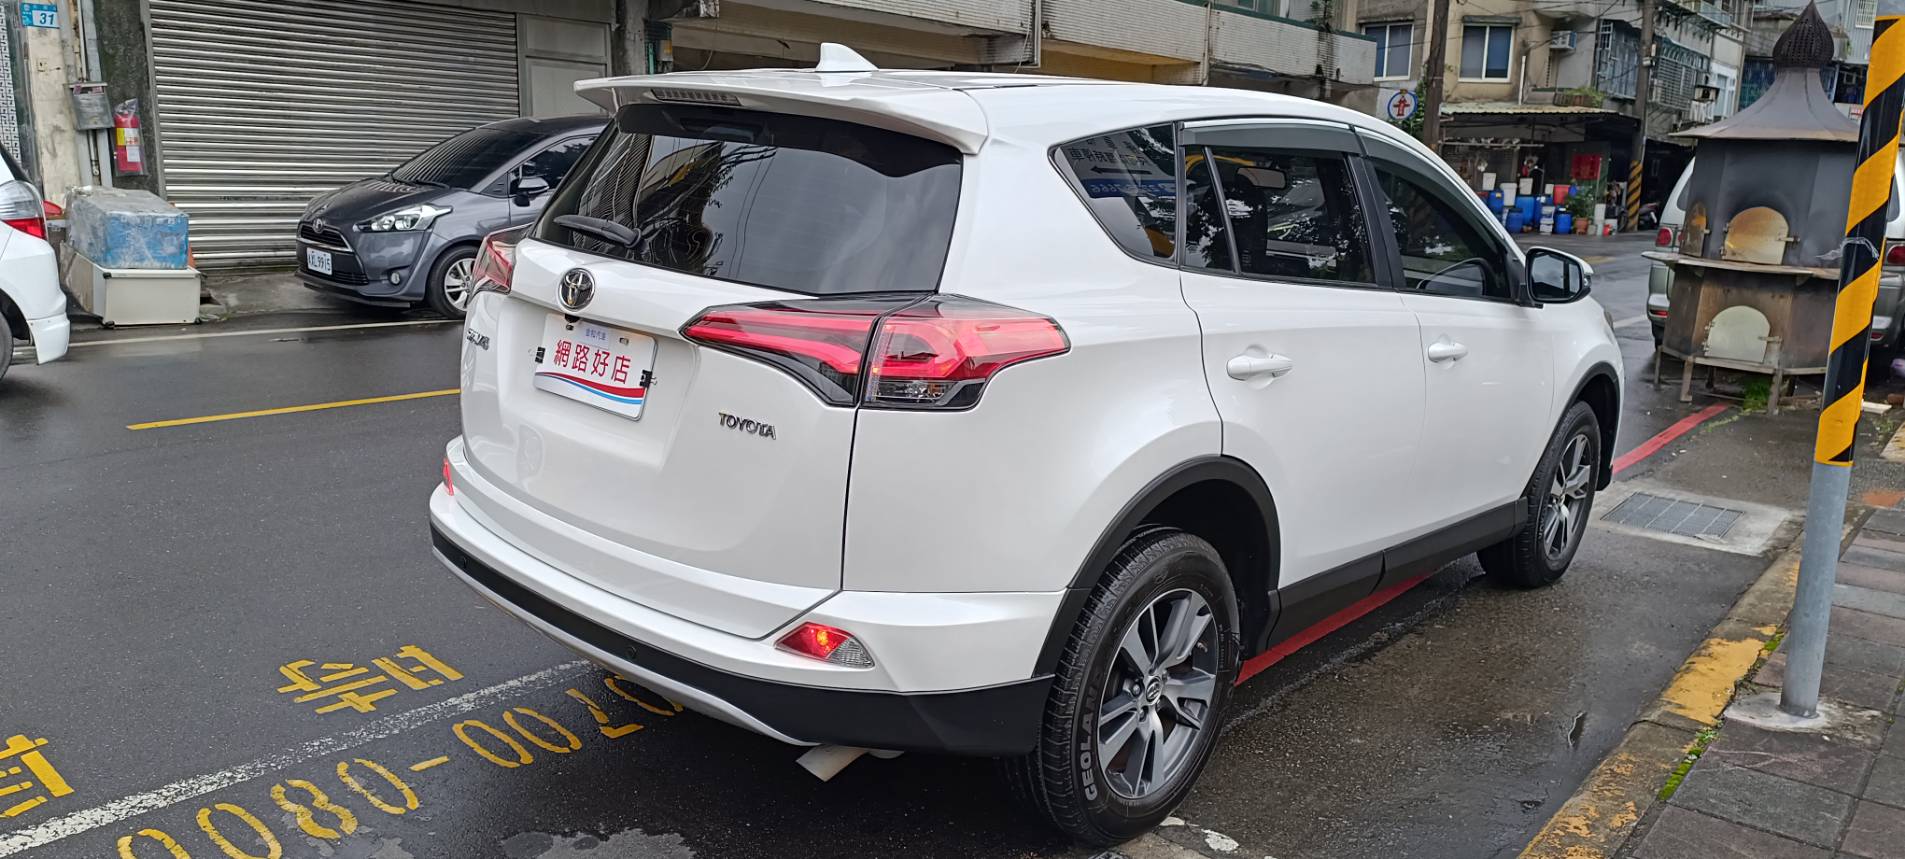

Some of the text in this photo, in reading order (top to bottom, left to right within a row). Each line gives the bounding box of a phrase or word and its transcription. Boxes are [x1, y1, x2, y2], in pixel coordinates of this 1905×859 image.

[40, 13, 54, 25] 31
[554, 340, 631, 384] 網路好店
[718, 412, 776, 440] TOYOTA
